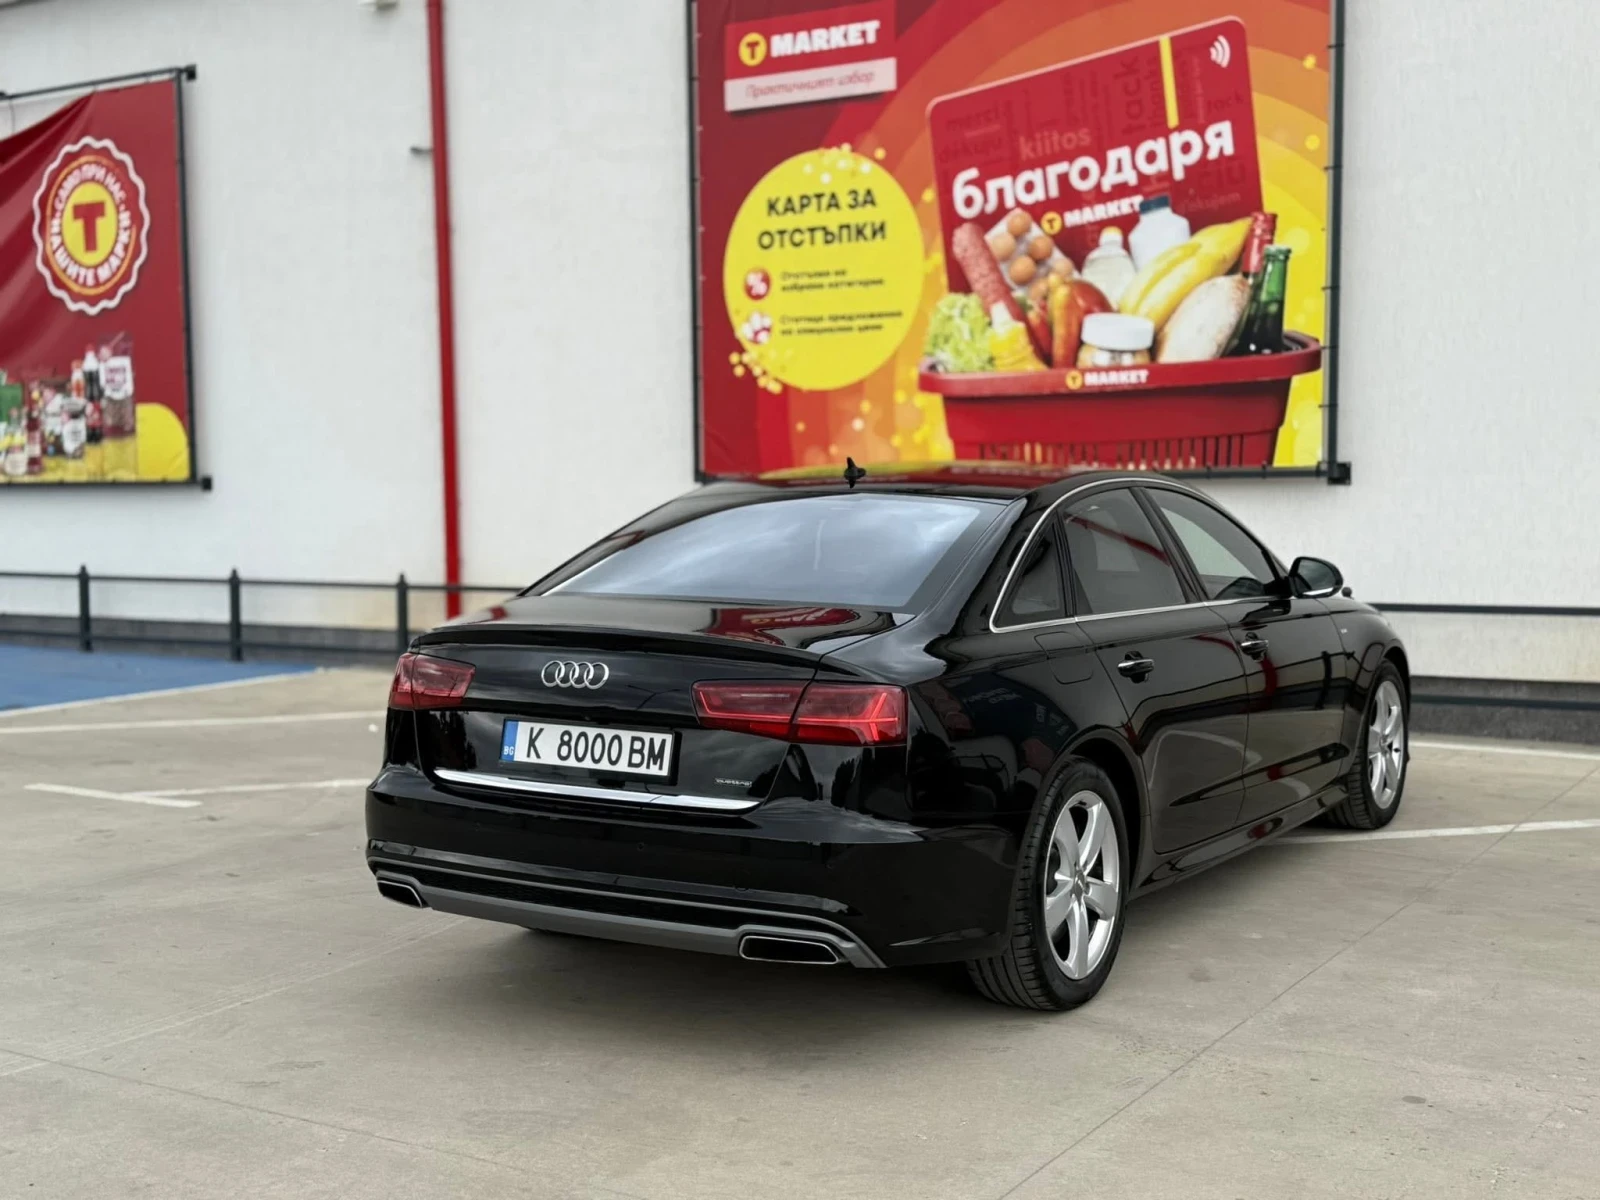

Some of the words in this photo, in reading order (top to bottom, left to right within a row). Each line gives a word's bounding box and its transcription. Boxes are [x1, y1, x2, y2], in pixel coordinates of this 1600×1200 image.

[770, 19, 880, 58] MARKET
[1018, 124, 1092, 162] kiitos
[951, 120, 1236, 219] благодаря
[767, 191, 841, 217] КАРТА
[848, 188, 877, 208] ЗА
[1063, 195, 1144, 228] MARKET
[758, 221, 886, 250] ОТСТЪПКИ
[1084, 369, 1149, 387] MARKET
[503, 745, 515, 756] BG
[526, 726, 545, 760] K
[557, 729, 623, 766] 8000
[627, 735, 667, 771] BM
